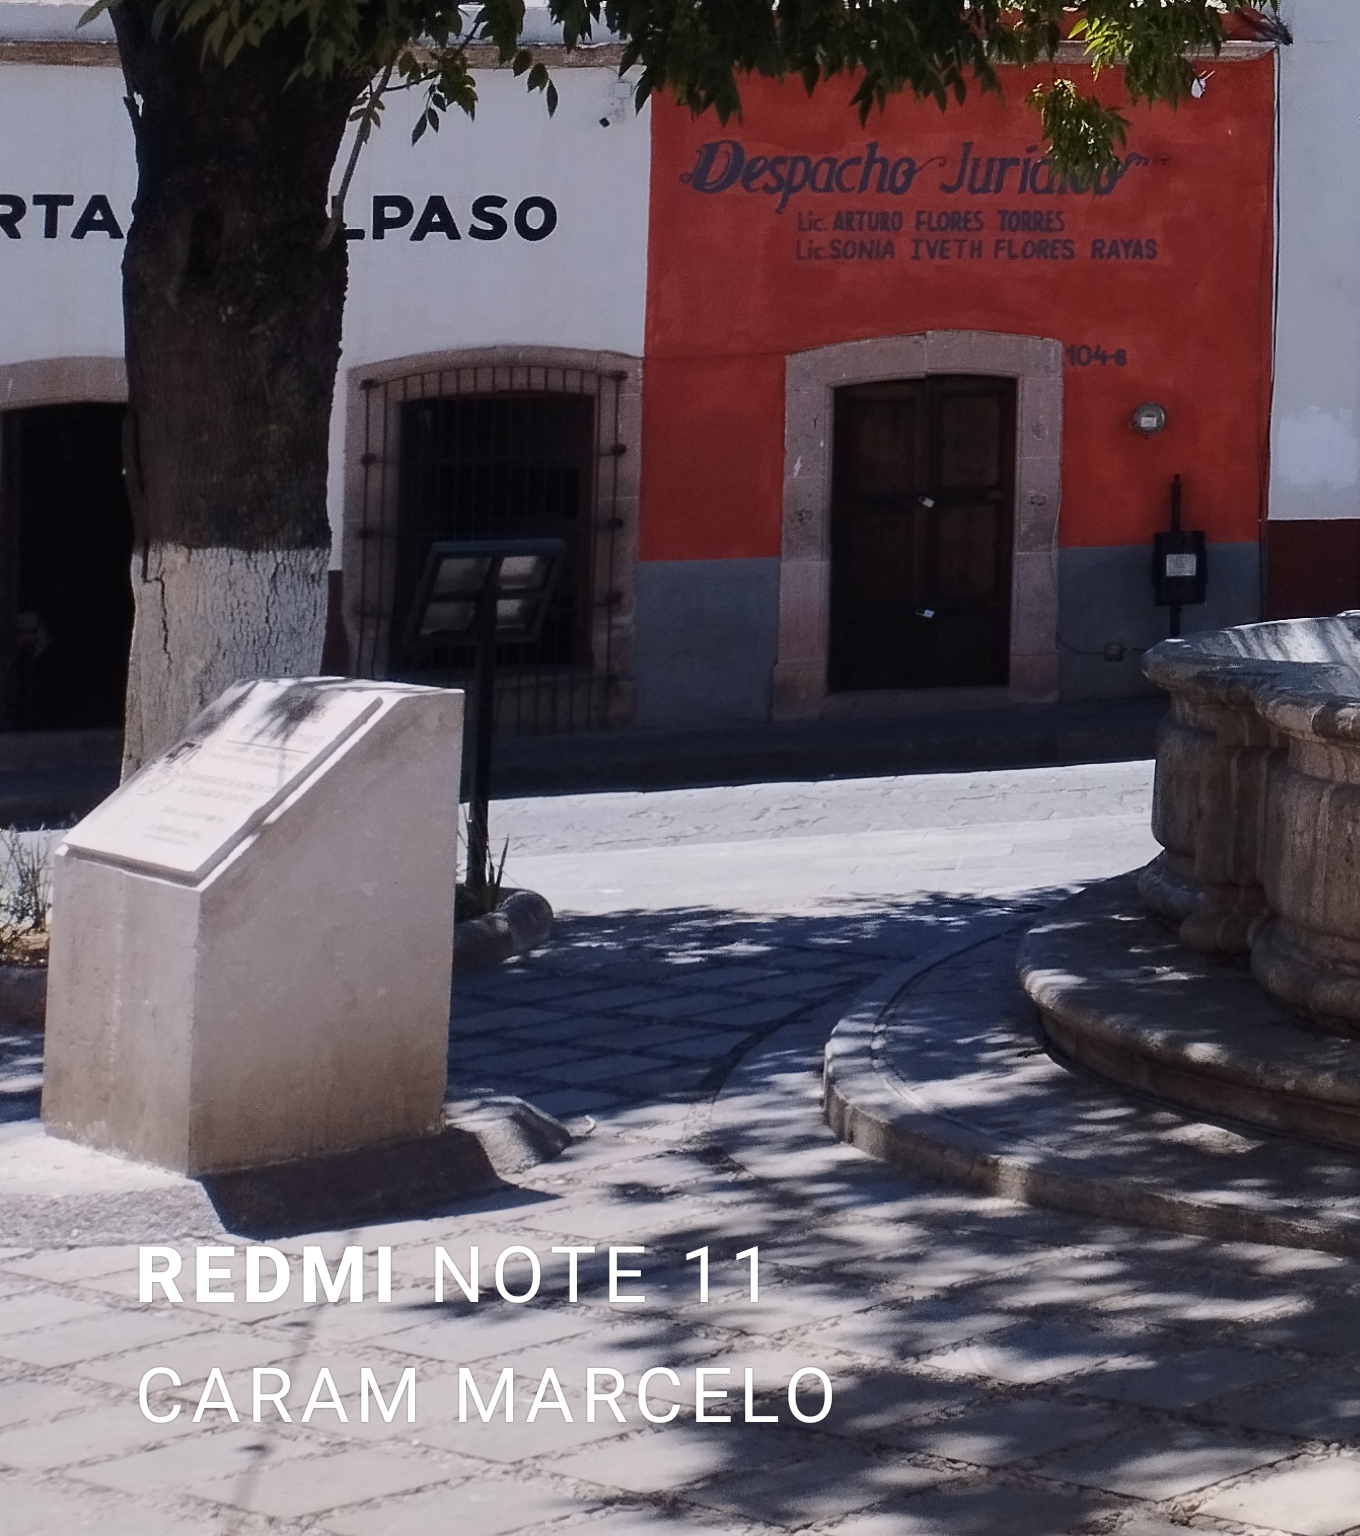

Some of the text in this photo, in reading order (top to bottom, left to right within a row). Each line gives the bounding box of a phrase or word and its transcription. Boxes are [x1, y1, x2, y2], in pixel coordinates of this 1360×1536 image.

[680, 139, 940, 214] Despacho
[834, 210, 904, 232] ARTURO
[915, 210, 985, 232] FLORES
[997, 210, 1066, 233] TORRES
[829, 239, 895, 261] SONIA
[910, 239, 983, 261] IVETH
[993, 239, 1076, 261] FLORES
[1090, 239, 1158, 261] RAYAS
